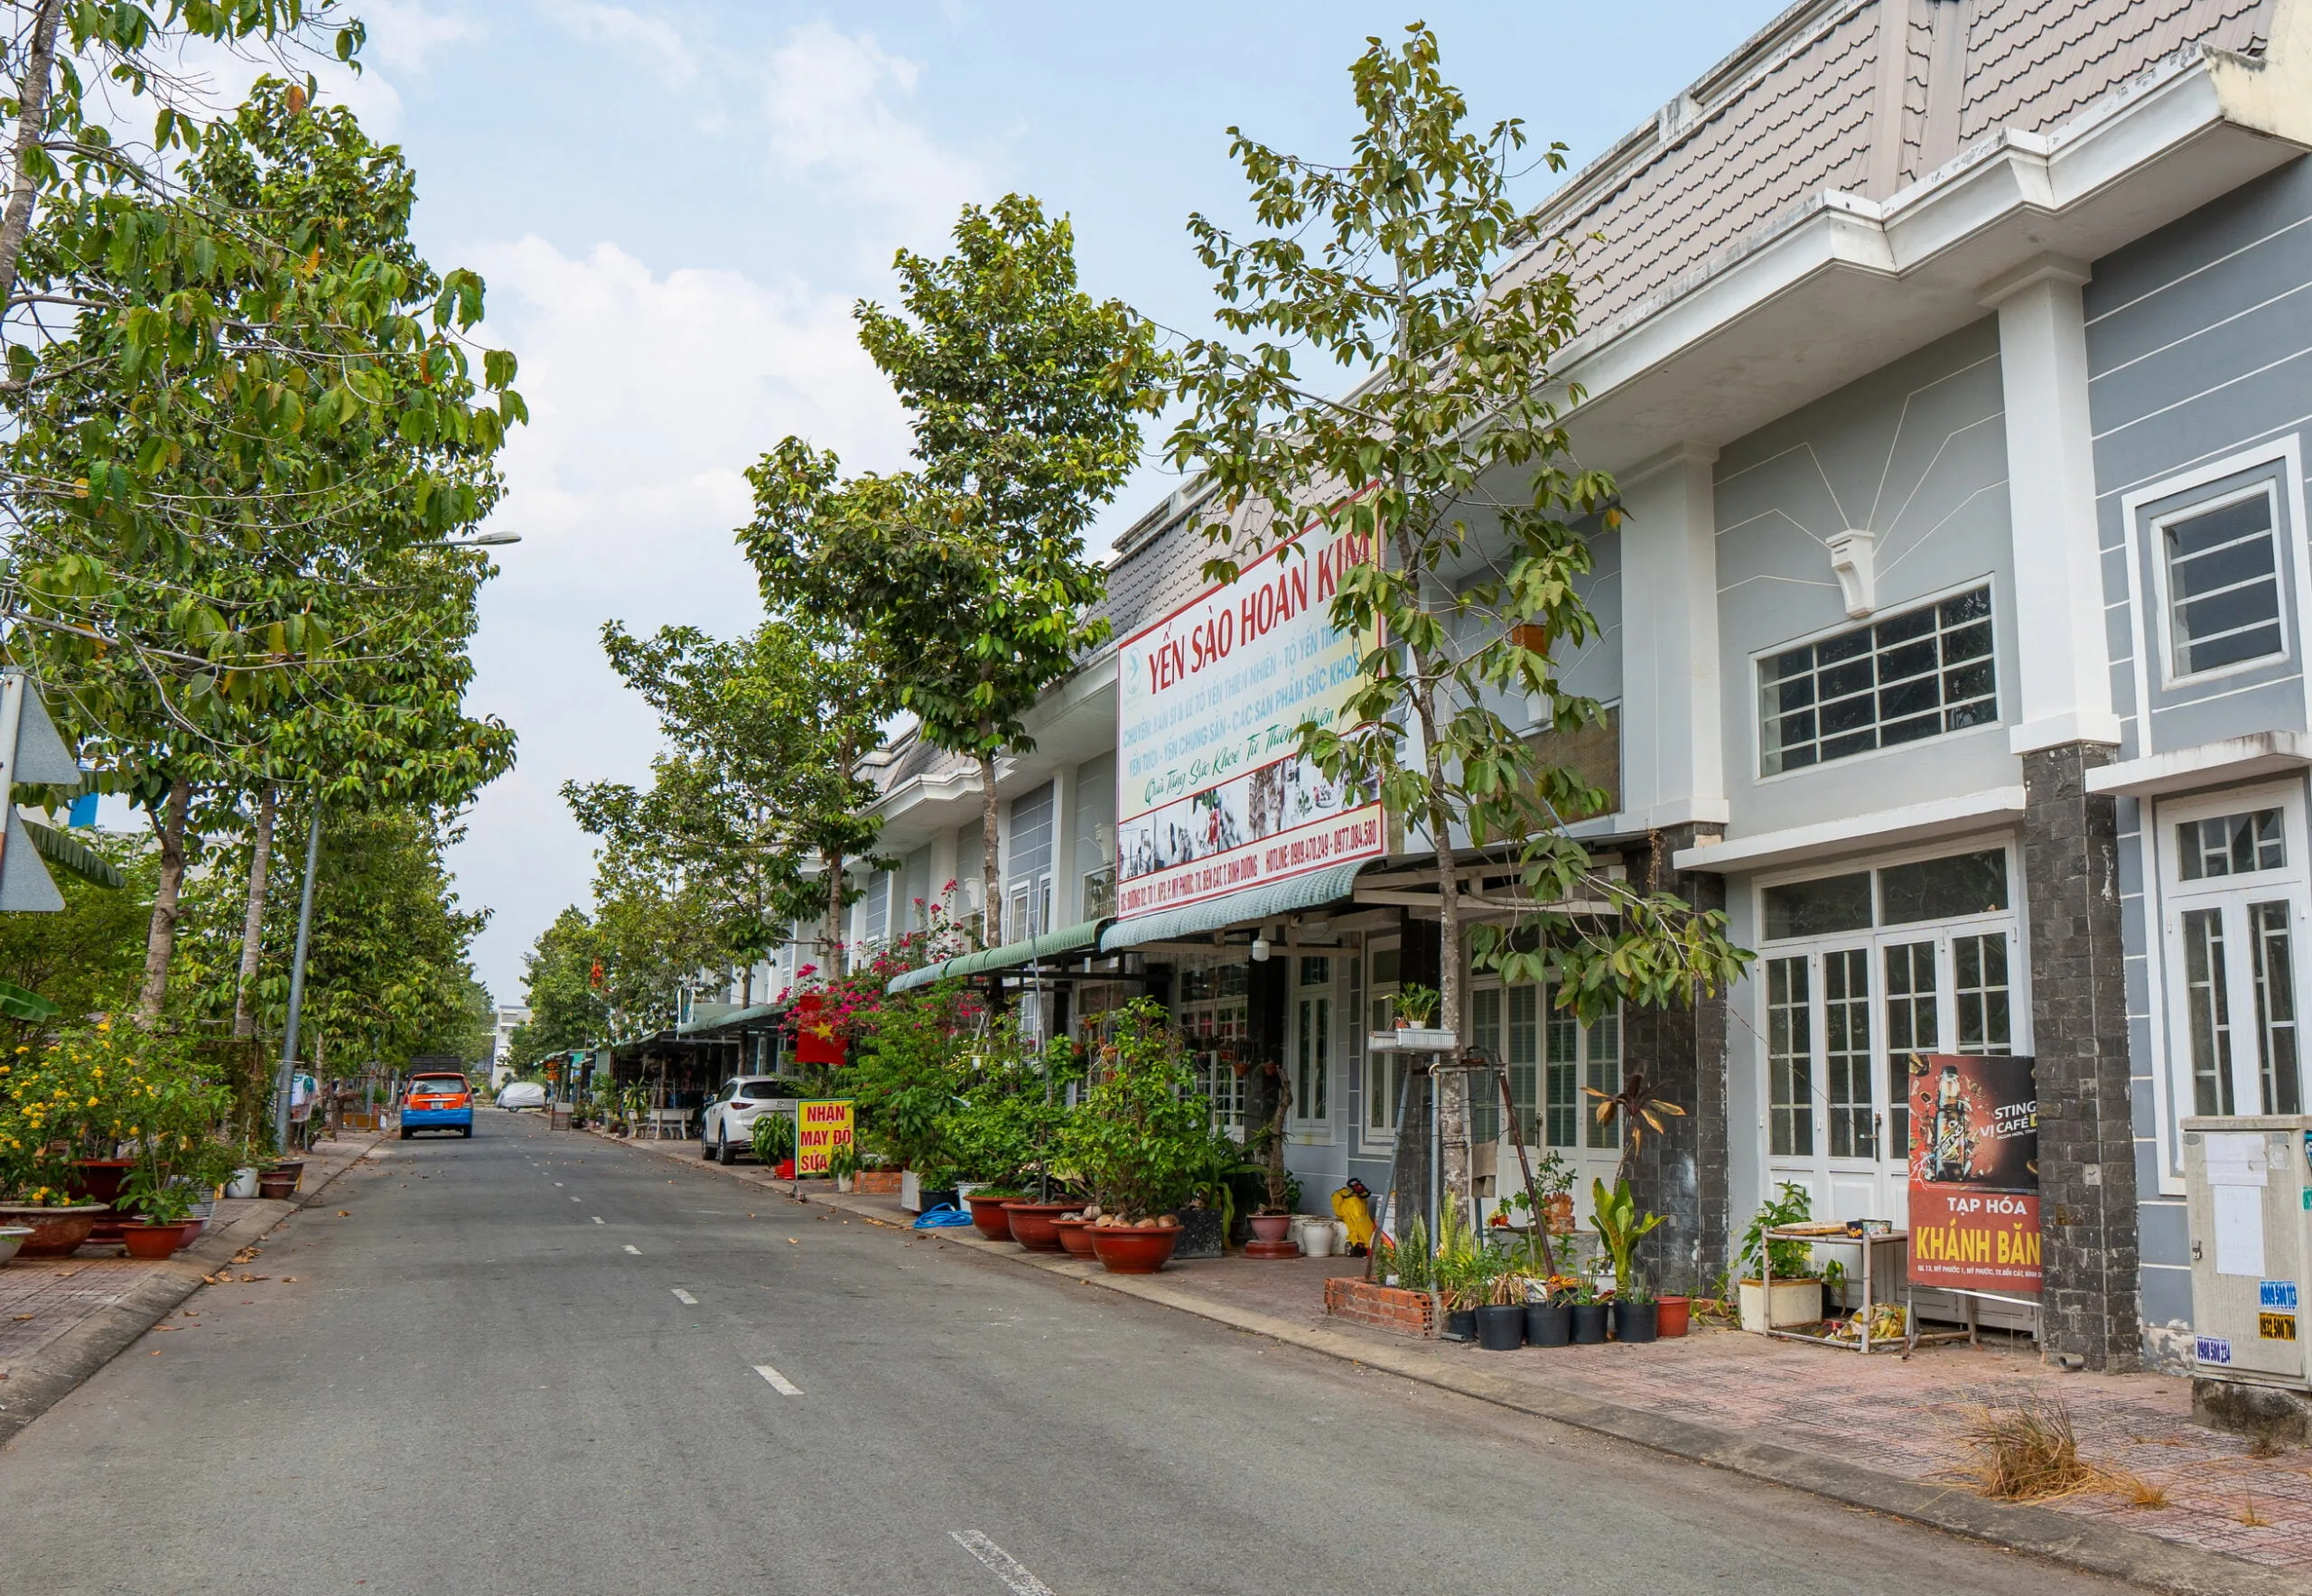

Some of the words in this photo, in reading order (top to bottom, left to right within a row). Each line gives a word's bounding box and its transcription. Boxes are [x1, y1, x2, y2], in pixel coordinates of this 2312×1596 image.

[1148, 621, 1185, 695] YẾN
[1191, 605, 1233, 673] SÀO
[1250, 650, 1276, 686] NHIÊN
[1300, 623, 1318, 660] YẾN
[1306, 664, 1326, 697] SỨC
[807, 1103, 845, 1125] NHẬN
[1994, 1101, 2036, 1120] STING
[800, 1131, 828, 1146] MAY
[801, 1150, 827, 1171] SỬA
[1947, 1197, 1981, 1217] TẠP
[1986, 1195, 2027, 1215] HÓA
[1916, 1218, 1990, 1262] KHÁNH
[1997, 1223, 2040, 1265] BĂN
